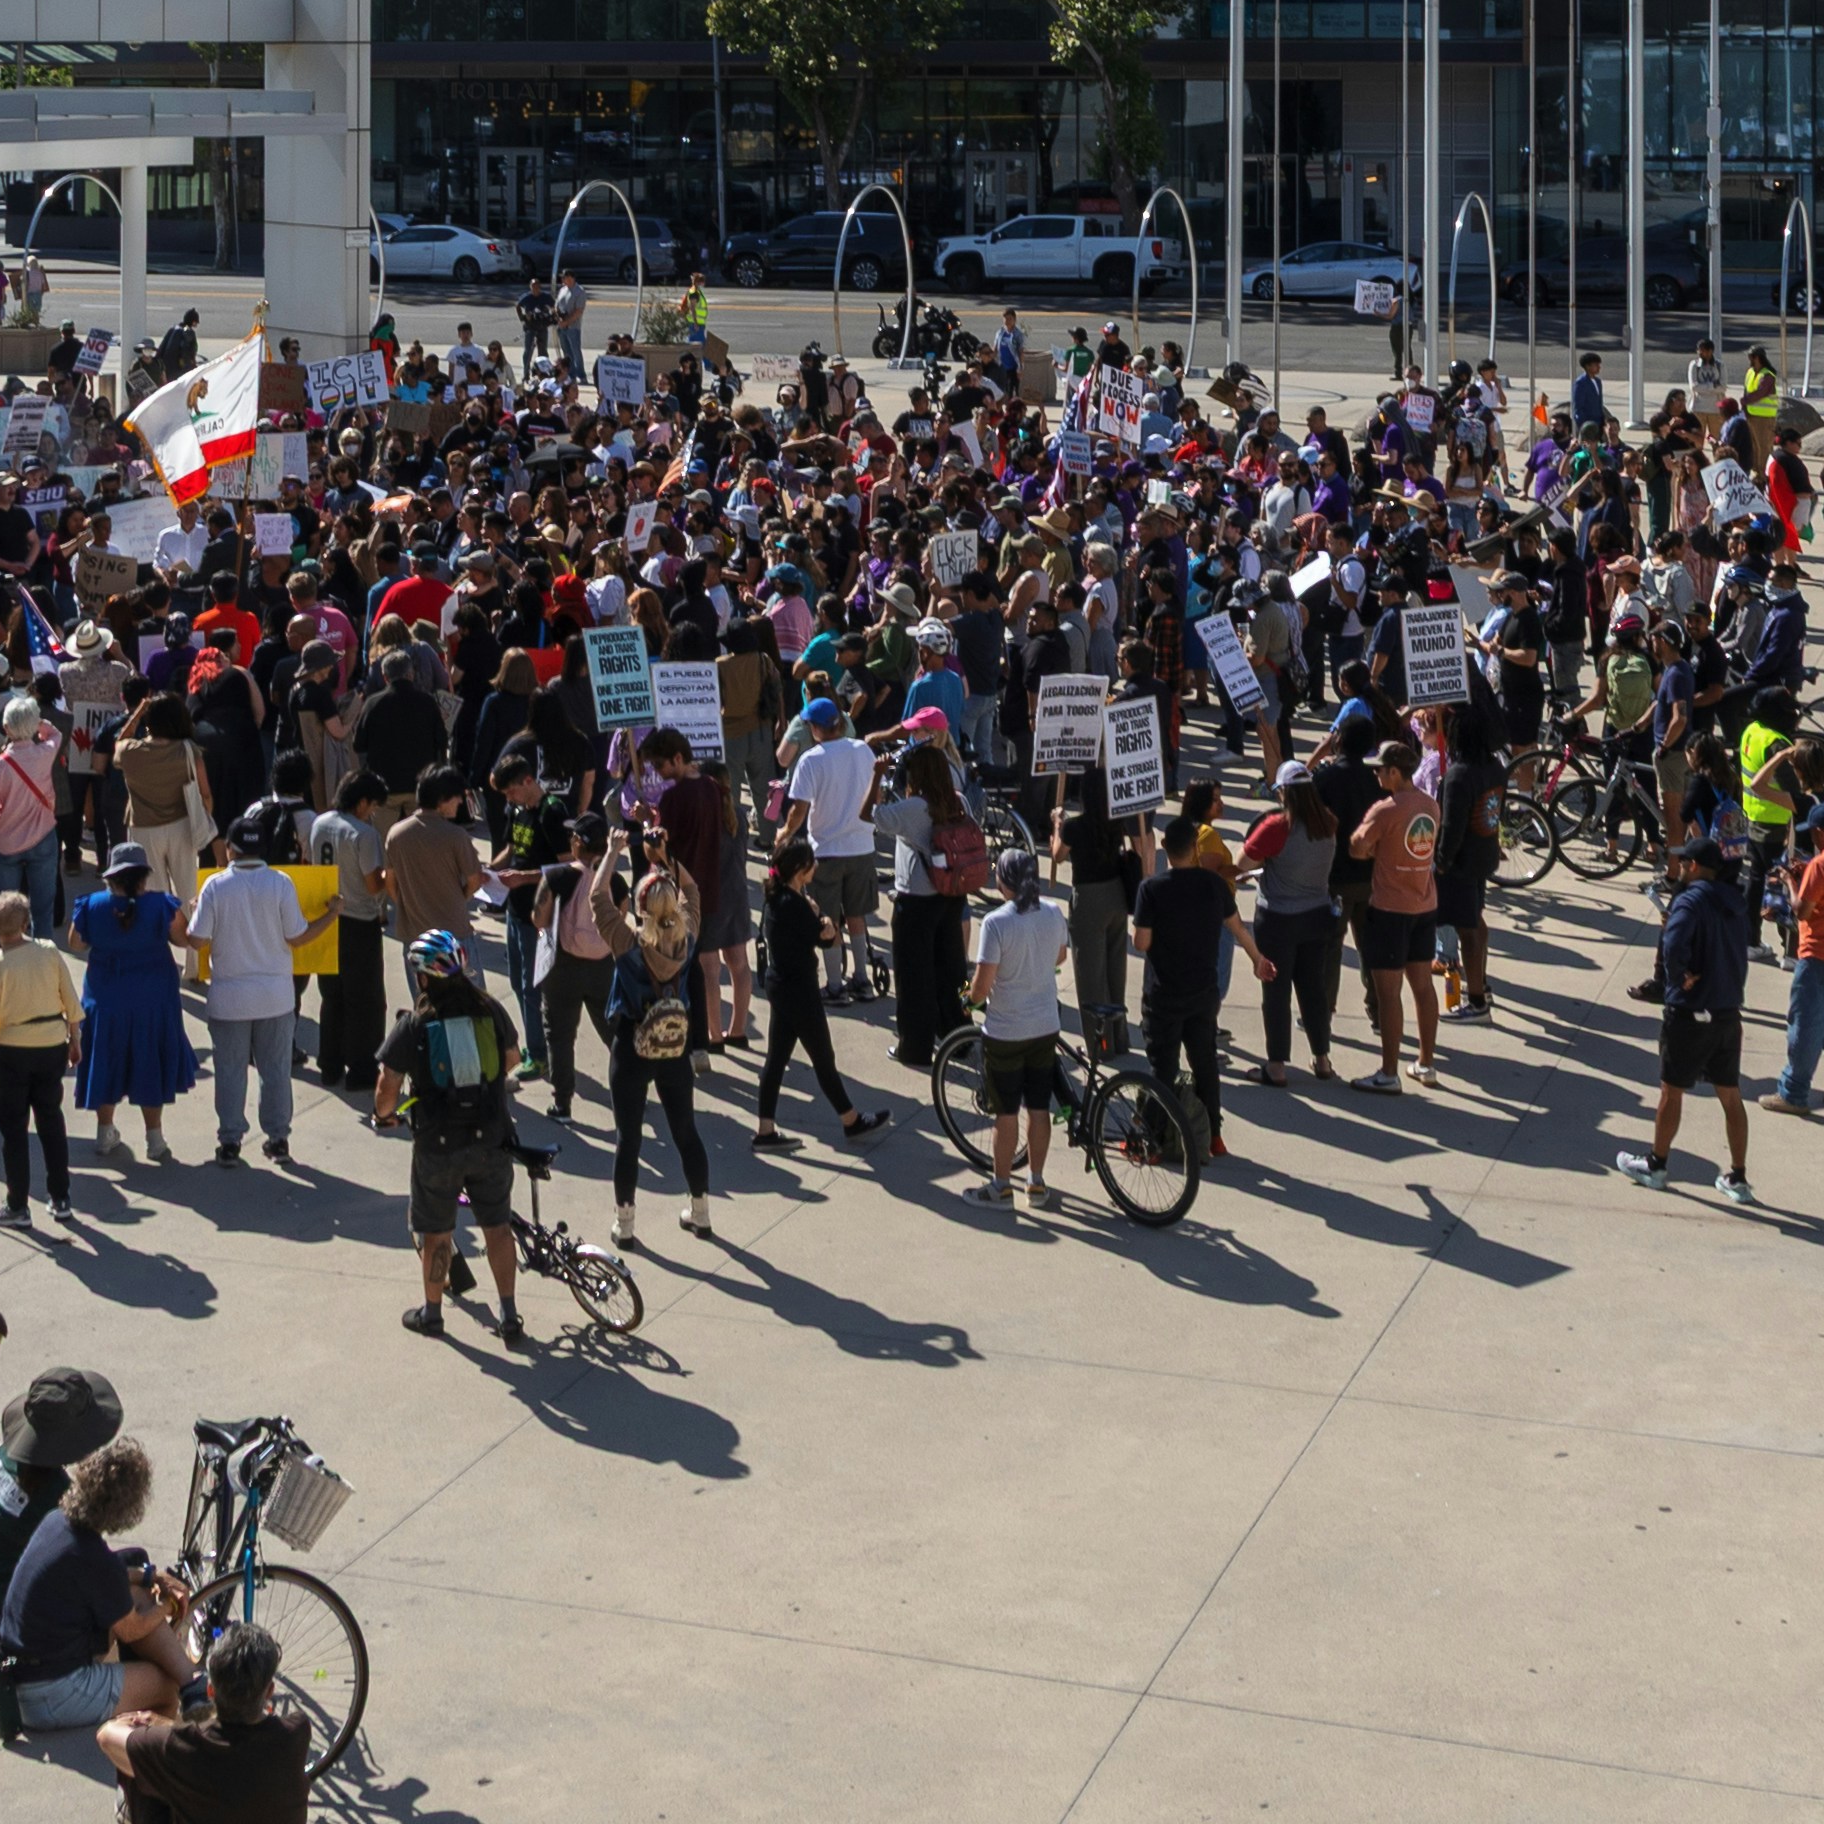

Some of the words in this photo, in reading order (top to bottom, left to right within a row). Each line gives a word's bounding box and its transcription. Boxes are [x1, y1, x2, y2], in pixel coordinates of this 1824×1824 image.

[84, 340, 108, 354] NO
[309, 353, 375, 390] ICE
[1110, 369, 1133, 390] DUE
[320, 377, 380, 414] OUT
[1102, 382, 1141, 408] PROCESS
[1104, 399, 1139, 425] NOW
[26, 487, 64, 504] SEIU
[936, 537, 975, 567] FUCK
[87, 557, 127, 574] SING
[1405, 609, 1459, 625] TRABAJADORES
[589, 630, 640, 645] REPRODUCTIVE
[1407, 624, 1442, 639] MUEVEN
[1443, 622, 1457, 635] AL
[598, 642, 613, 656] AND
[614, 642, 637, 654] TRANS
[1411, 635, 1455, 654] MUNDO
[599, 654, 642, 675] RIGHTS
[1408, 656, 1463, 673] TRABAJADORES
[674, 669, 712, 678] PUEBLO
[1410, 670, 1435, 682] DEBEN
[596, 684, 613, 697] ONE
[614, 680, 649, 694] STRUGGLE
[1041, 684, 1102, 699] ¡LEGALIZACIÓN
[1414, 682, 1426, 695] EL
[1427, 678, 1462, 694] MUNDO
[600, 698, 624, 716] ONE
[625, 695, 651, 713] FIGHT
[661, 698, 673, 706] LA
[676, 696, 716, 706] AGENDA
[1043, 705, 1063, 718] PARA
[1066, 704, 1098, 717] TODOS!
[1108, 702, 1153, 724] REPRODUCTIVE
[1115, 722, 1129, 735] AND
[1131, 717, 1150, 731] TRANS
[685, 732, 719, 742] RUMP!
[1115, 729, 1153, 756] RIGHTS
[1037, 750, 1045, 759] EN
[1046, 749, 1055, 759] LA
[1056, 748, 1095, 759] FRONTERA!
[1110, 767, 1126, 781] ONE
[1127, 758, 1159, 777] STRUGGLE
[1113, 780, 1134, 801] ONE
[1136, 775, 1160, 797] FIGHT
